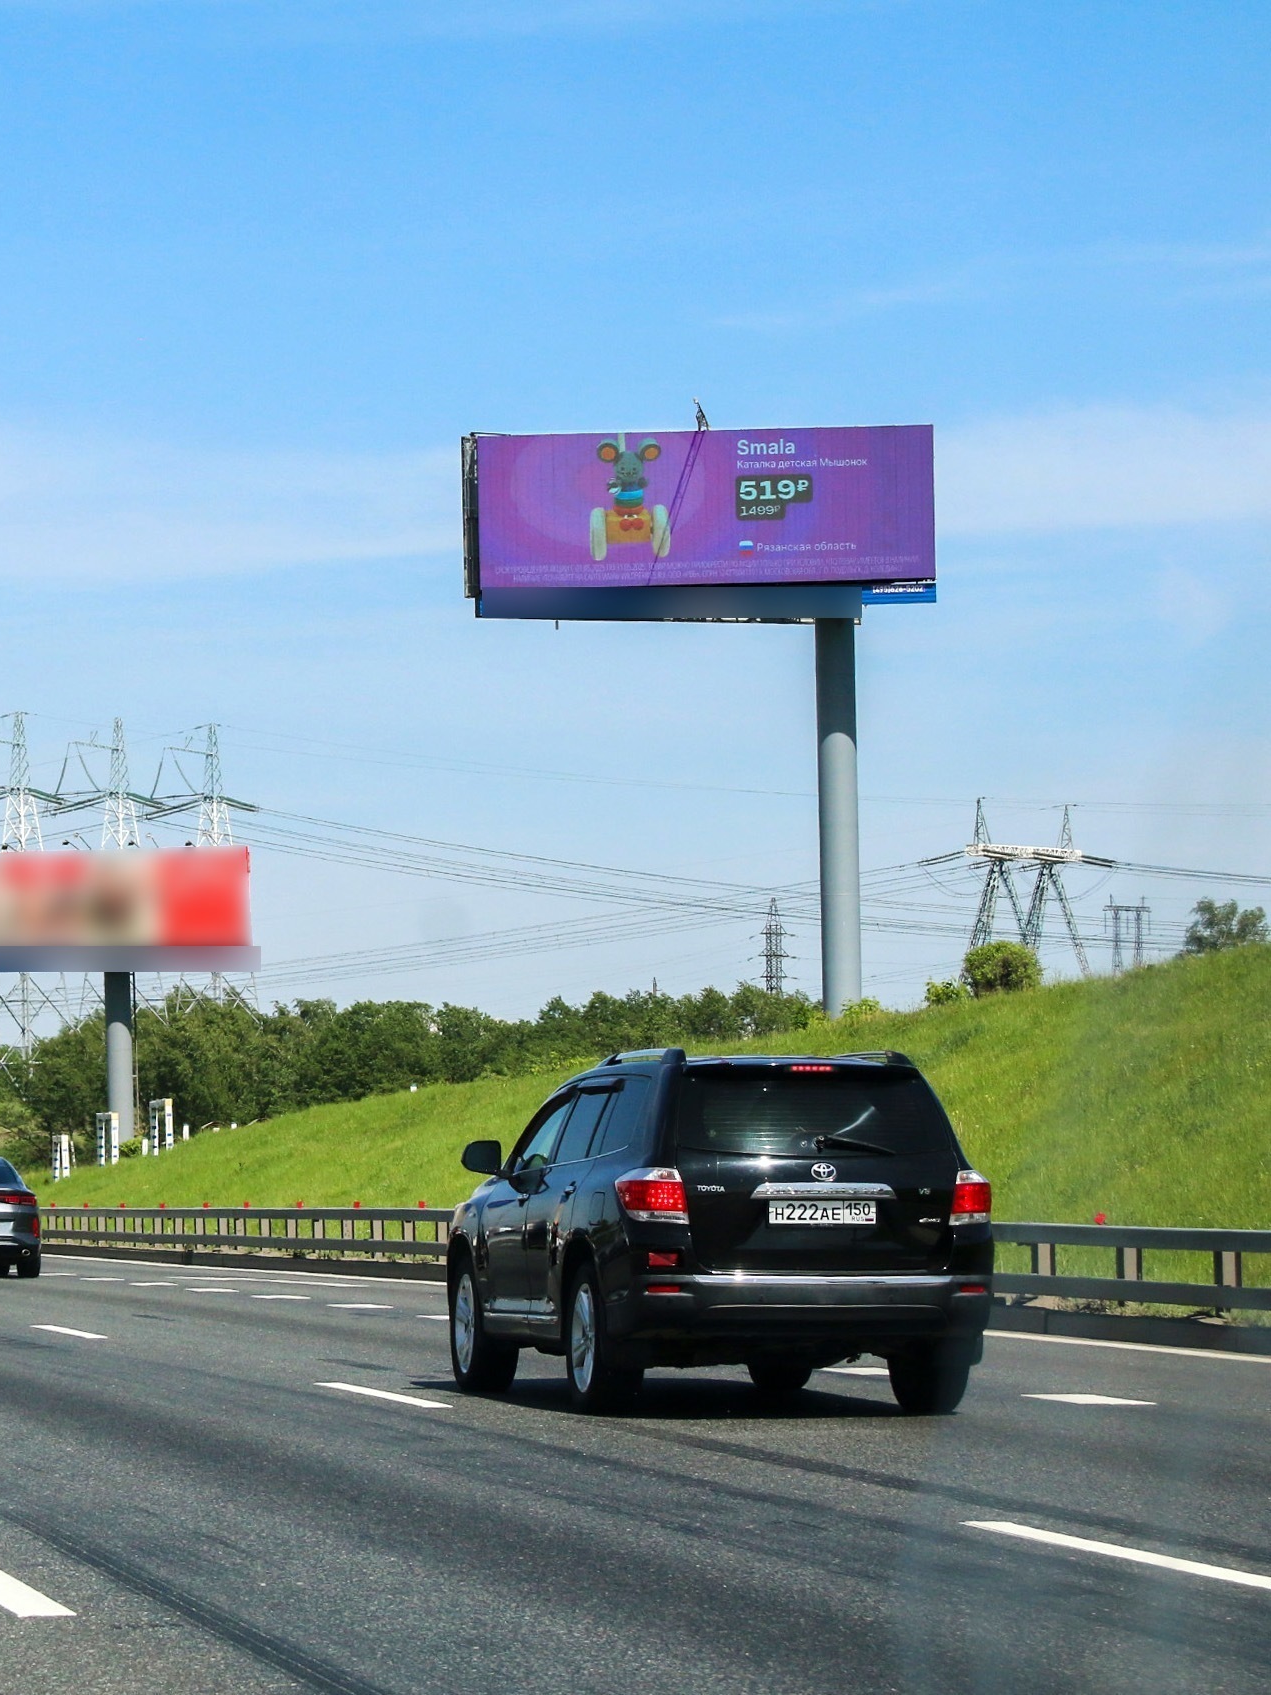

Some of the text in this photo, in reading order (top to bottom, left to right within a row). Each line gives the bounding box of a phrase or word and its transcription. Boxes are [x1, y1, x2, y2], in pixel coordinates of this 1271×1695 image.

[737, 439, 796, 456] Smala
[737, 458, 867, 469] Каталка детская Мышонок
[756, 542, 857, 552] Рязанская область
[696, 1184, 726, 1193] TOYOTA
[845, 1203, 871, 1216] 150
